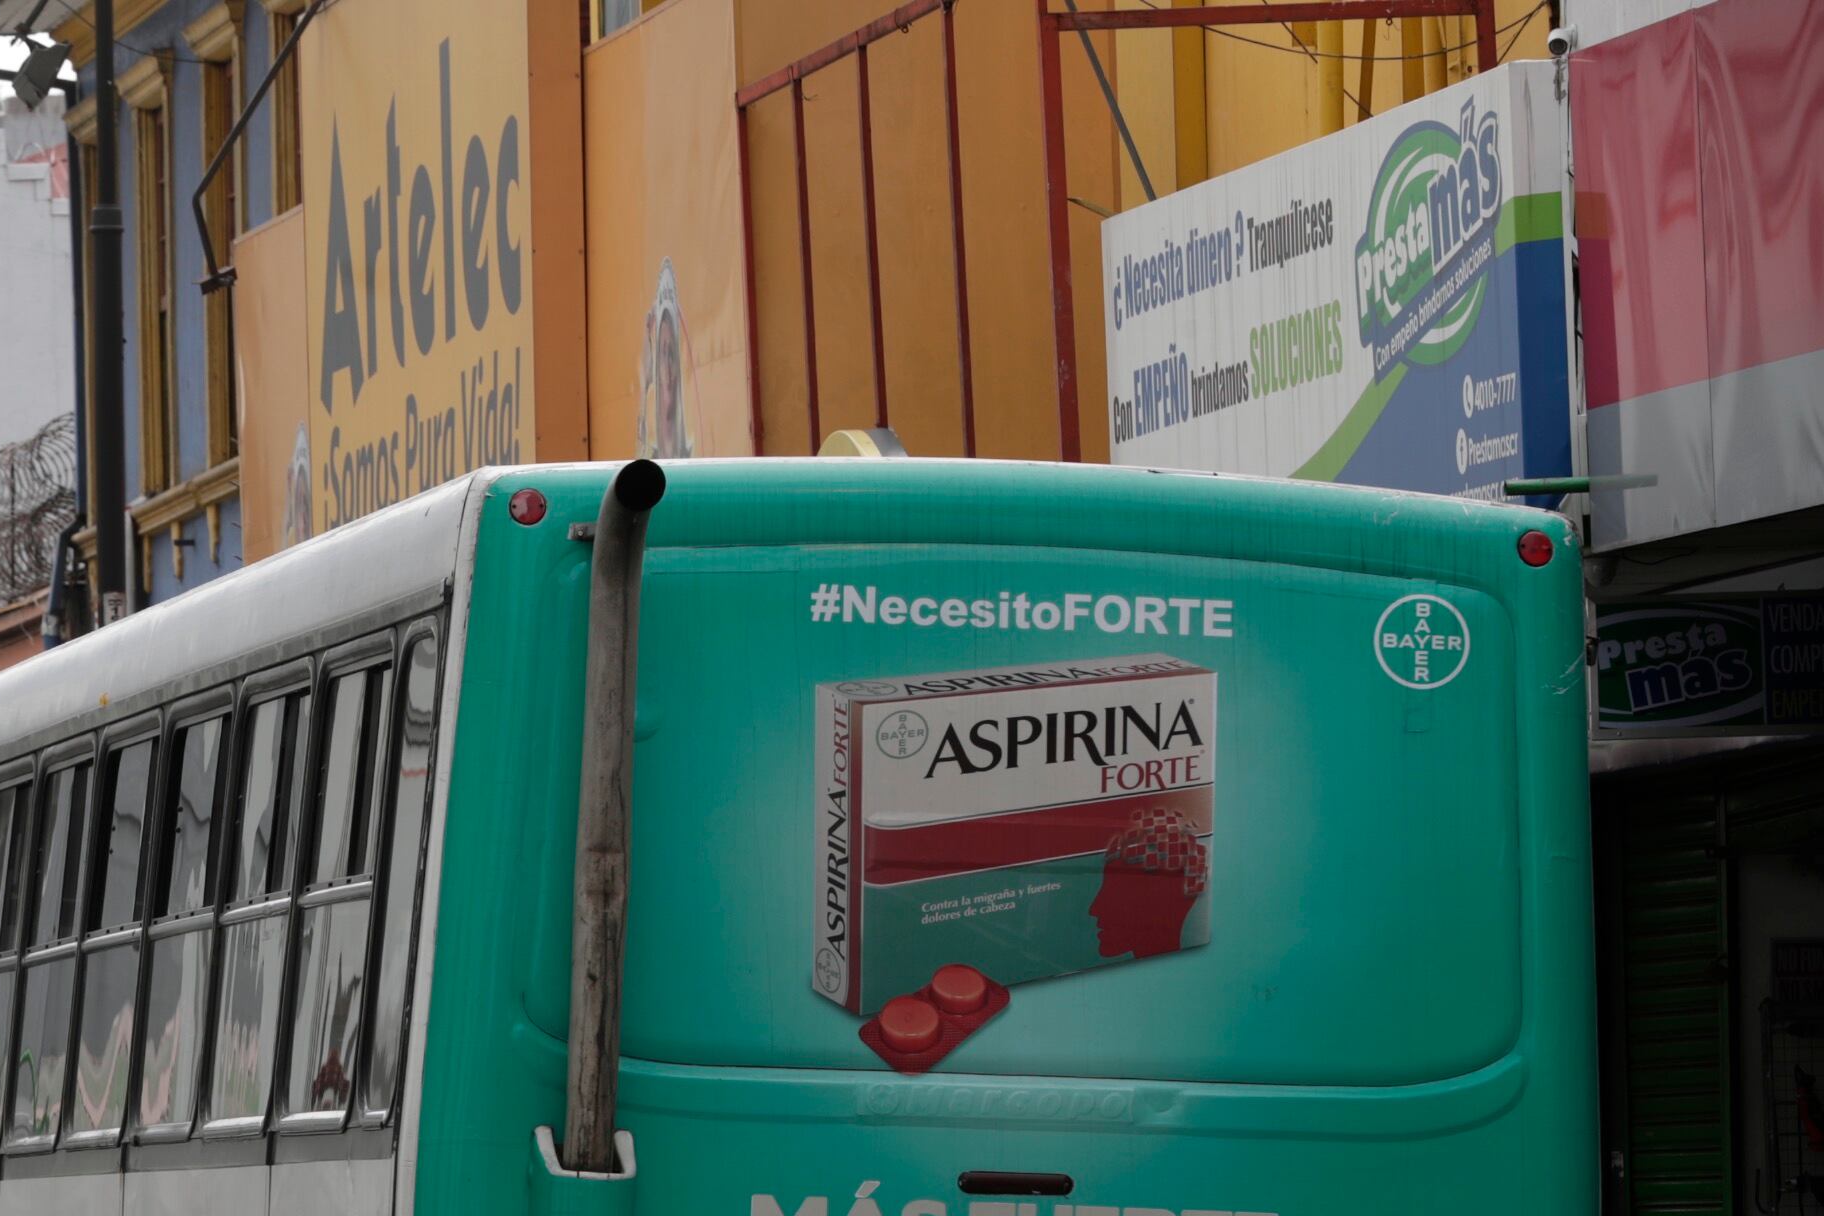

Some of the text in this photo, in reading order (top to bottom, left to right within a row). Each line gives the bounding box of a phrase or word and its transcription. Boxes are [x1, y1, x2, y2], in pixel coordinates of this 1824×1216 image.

[320, 37, 521, 416] Artelec
[1124, 239, 1184, 320] Necesita
[1186, 227, 1232, 296] dinero
[1247, 198, 1333, 273] Tranquílicese
[1376, 238, 1492, 371] Con empeño brindamos soluciones
[1113, 299, 1343, 444] Con EMPEÑO brindamos SOLUCIONES
[1475, 372, 1516, 411] 4010-7777
[406, 393, 456, 500] Pura
[461, 346, 520, 472] Vida!
[810, 583, 1234, 638] #NecesitoFORTE
[1383, 633, 1462, 650] BAYER
[904, 667, 1096, 697] ASPIRINA
[1094, 661, 1185, 677] FORTE
[923, 698, 1206, 780] ASPIRINA
[1100, 753, 1202, 794] FORTE
[827, 788, 849, 961] ASPIRINA
[921, 900, 959, 913] Contra
[961, 895, 971, 906] la
[974, 888, 1016, 904] migraña
[1027, 882, 1062, 895] fuertes
[921, 901, 1016, 925] dolores de cabeza
